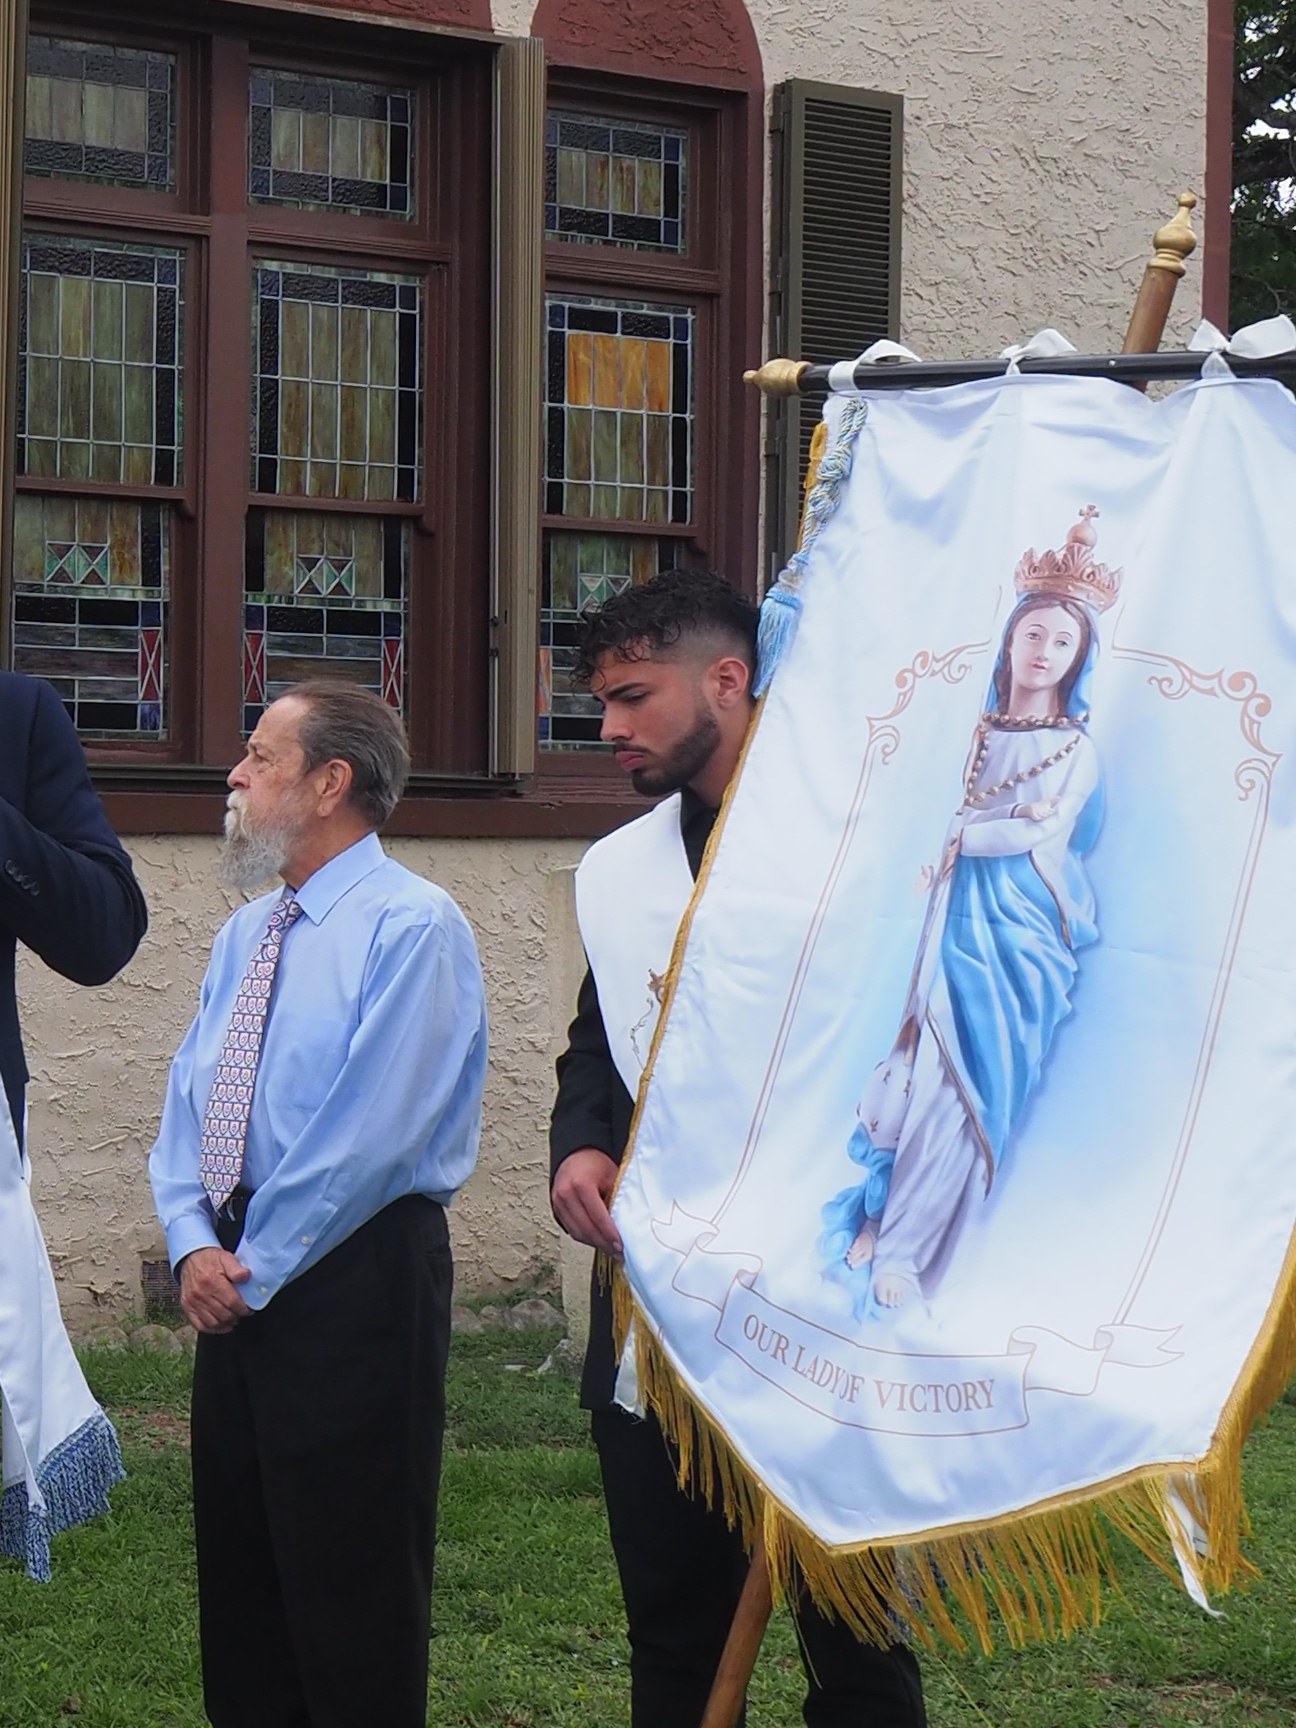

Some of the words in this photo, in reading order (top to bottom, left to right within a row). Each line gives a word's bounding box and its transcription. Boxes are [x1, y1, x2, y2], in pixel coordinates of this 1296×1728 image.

[743, 1314, 789, 1366] OUR
[792, 1344, 846, 1395] LADY
[873, 1379, 995, 1413] VICTORY
